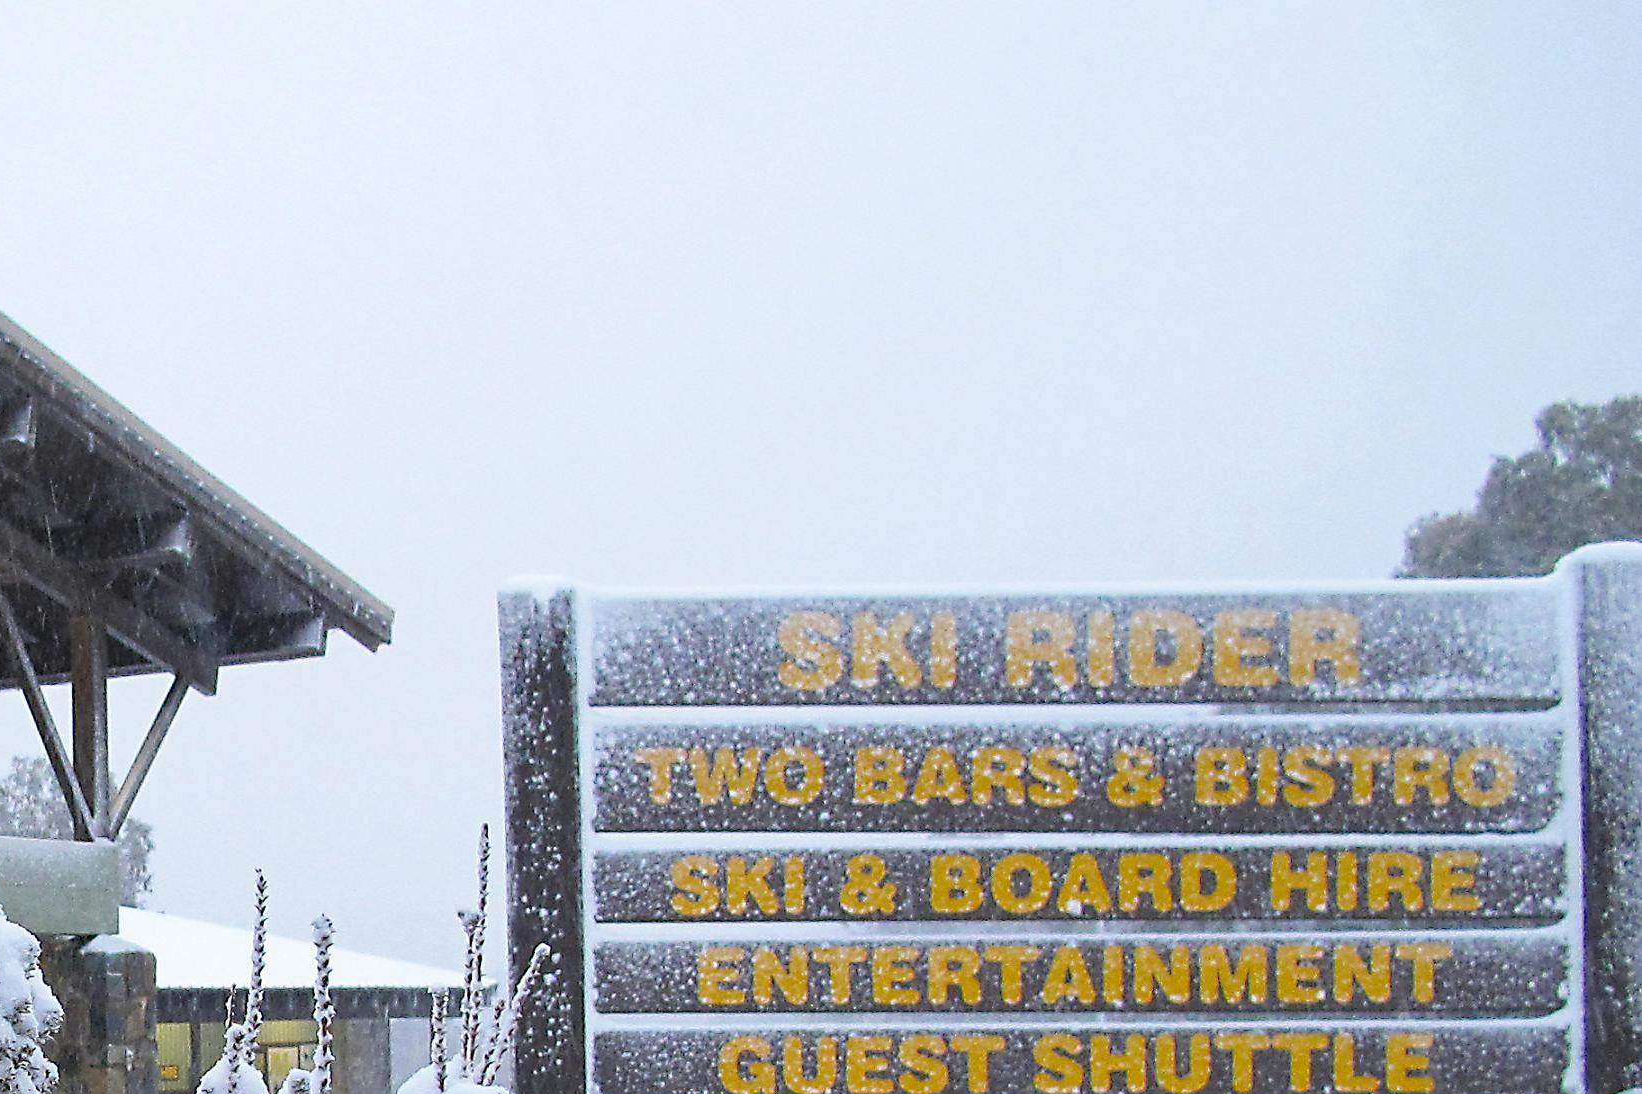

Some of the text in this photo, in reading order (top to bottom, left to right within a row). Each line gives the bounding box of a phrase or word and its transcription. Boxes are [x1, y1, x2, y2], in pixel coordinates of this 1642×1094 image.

[778, 609, 1359, 690] SKI RIDER
[637, 744, 1516, 807] TWO BARS & BISTRO
[670, 851, 1480, 916] SKI & BOARD HIRE
[696, 945, 1452, 1006] ENTERTAINMENT
[1032, 1033, 1435, 1094] SHUTTLE
